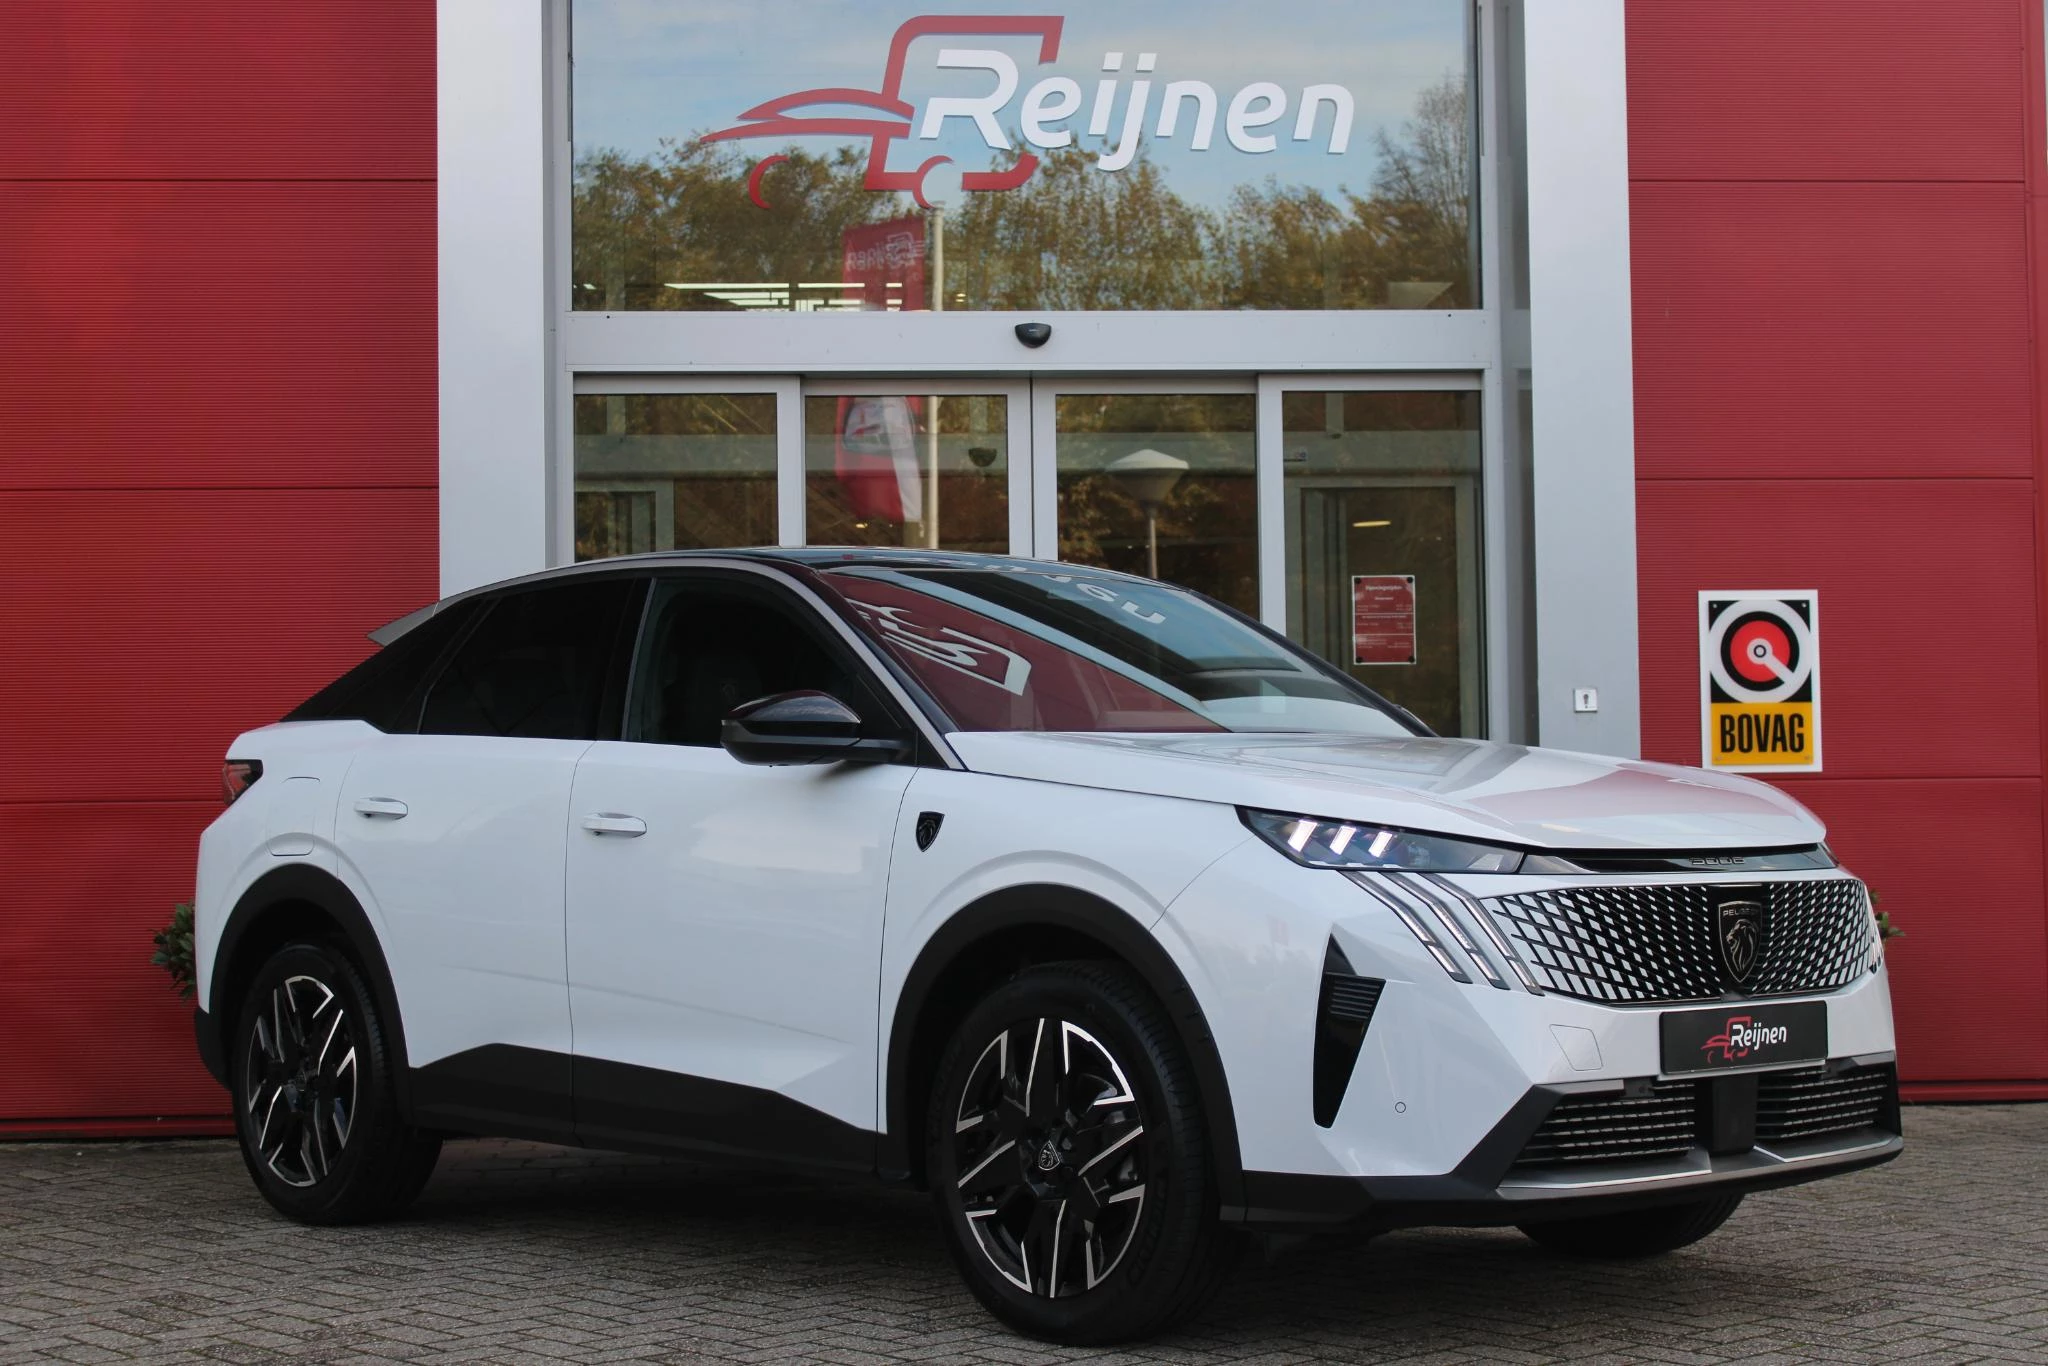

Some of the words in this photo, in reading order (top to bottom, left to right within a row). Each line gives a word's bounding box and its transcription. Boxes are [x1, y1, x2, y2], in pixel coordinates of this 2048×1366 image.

[920, 49, 1355, 172] Reijnen
[1720, 713, 1805, 754] BOVAG
[1731, 1022, 1787, 1050] Reijnen
